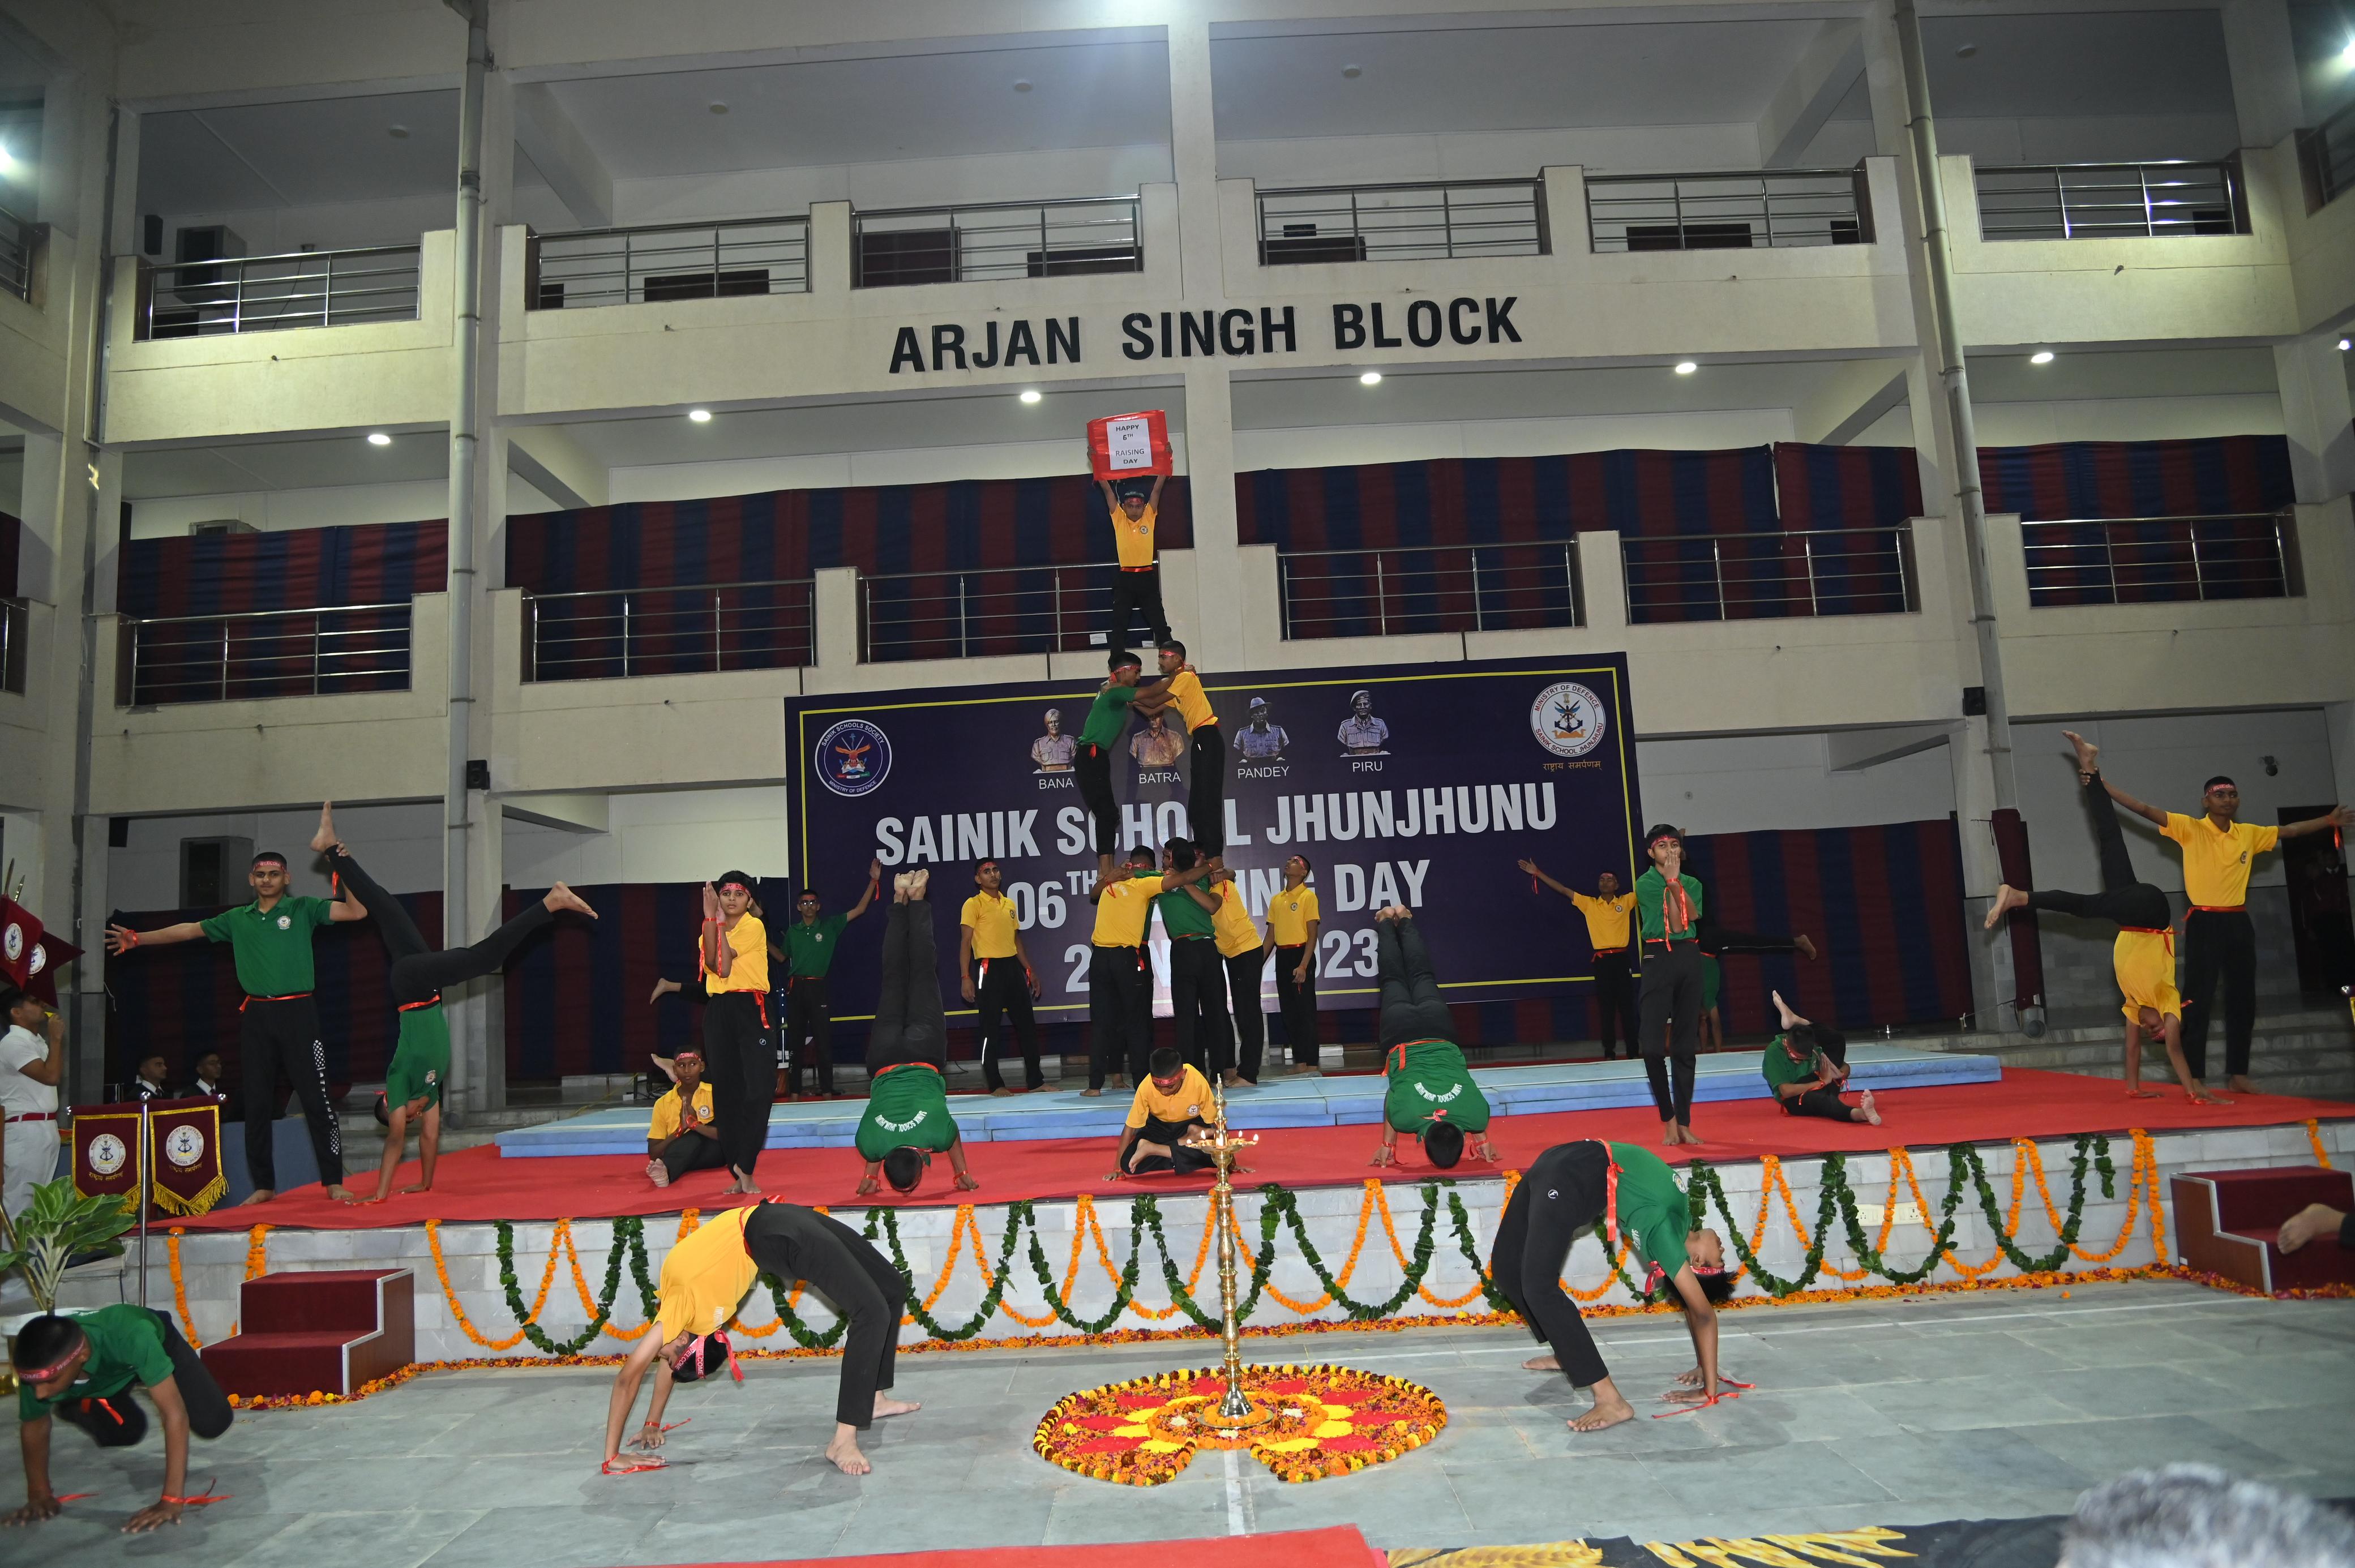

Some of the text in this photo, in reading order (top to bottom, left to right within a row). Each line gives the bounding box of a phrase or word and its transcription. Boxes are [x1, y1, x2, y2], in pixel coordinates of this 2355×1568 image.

[889, 296, 1523, 374] ARJAN SINGH BLOCK
[1115, 448, 1145, 457] RAISING
[1534, 686, 1558, 712] MINISTRY
[1572, 686, 1600, 709] DEFENCE
[821, 722, 885, 747] SAINIK SCHOOLS SOCIETY
[1535, 722, 1603, 754] SAINIK SCHOOL JHUNJHUNU
[1238, 766, 1290, 779] PANDEY
[1352, 760, 1383, 773] PIRU
[1039, 777, 1074, 790] BANA
[1138, 772, 1181, 784] BATRA
[828, 779, 849, 793] MINISTRY
[856, 779, 877, 793] DEFENCE
[875, 782, 1557, 866] SAINIK SHOL JHUNJHUNU
[1334, 859, 1431, 912] DAY
[1437, 1091, 1455, 1103] SCHOOL
[898, 1120, 917, 1132] SCHOOL
